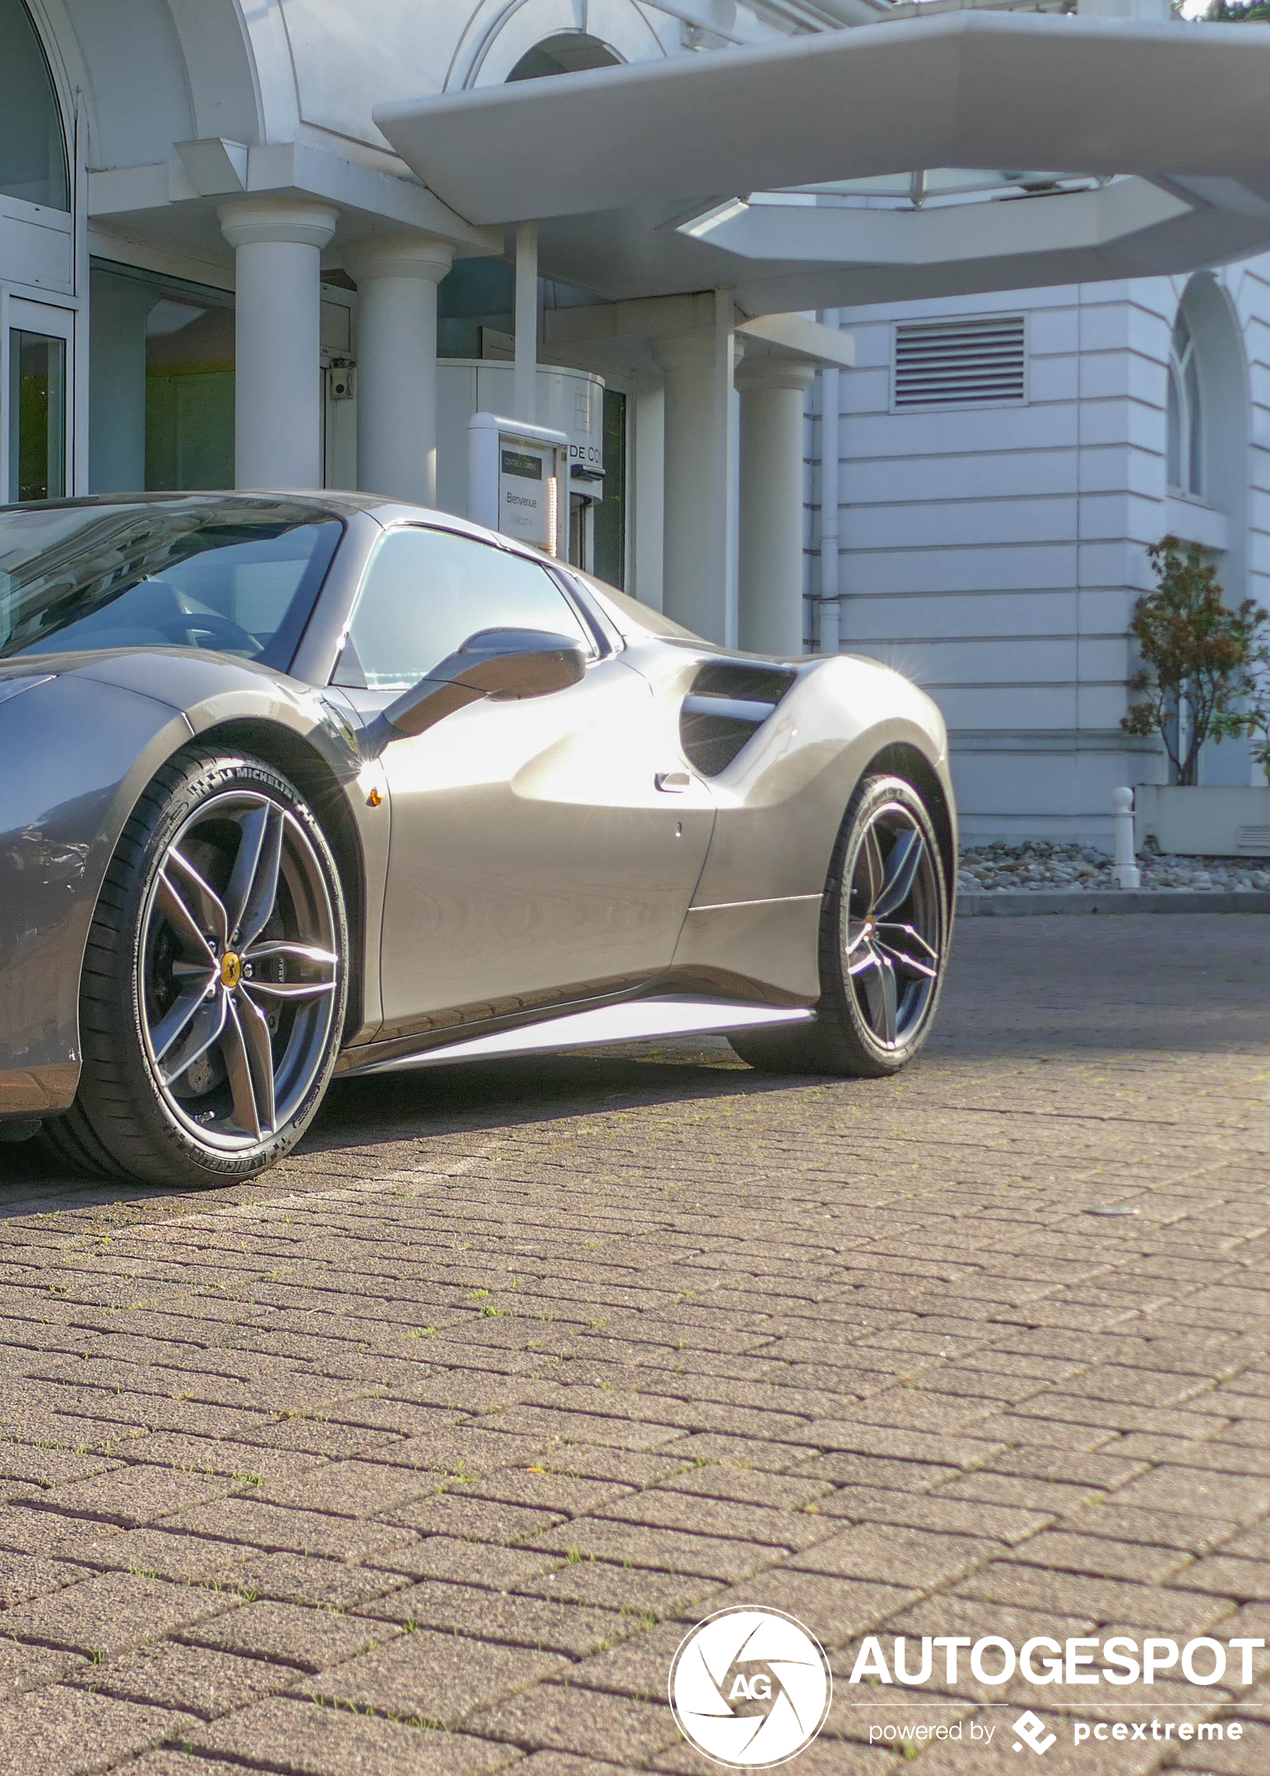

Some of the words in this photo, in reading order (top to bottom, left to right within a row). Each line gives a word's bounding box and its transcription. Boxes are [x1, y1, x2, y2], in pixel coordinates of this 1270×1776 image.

[570, 445, 585, 459] DE
[507, 492, 537, 508] Bienvenue
[236, 767, 294, 799] MICHELIN
